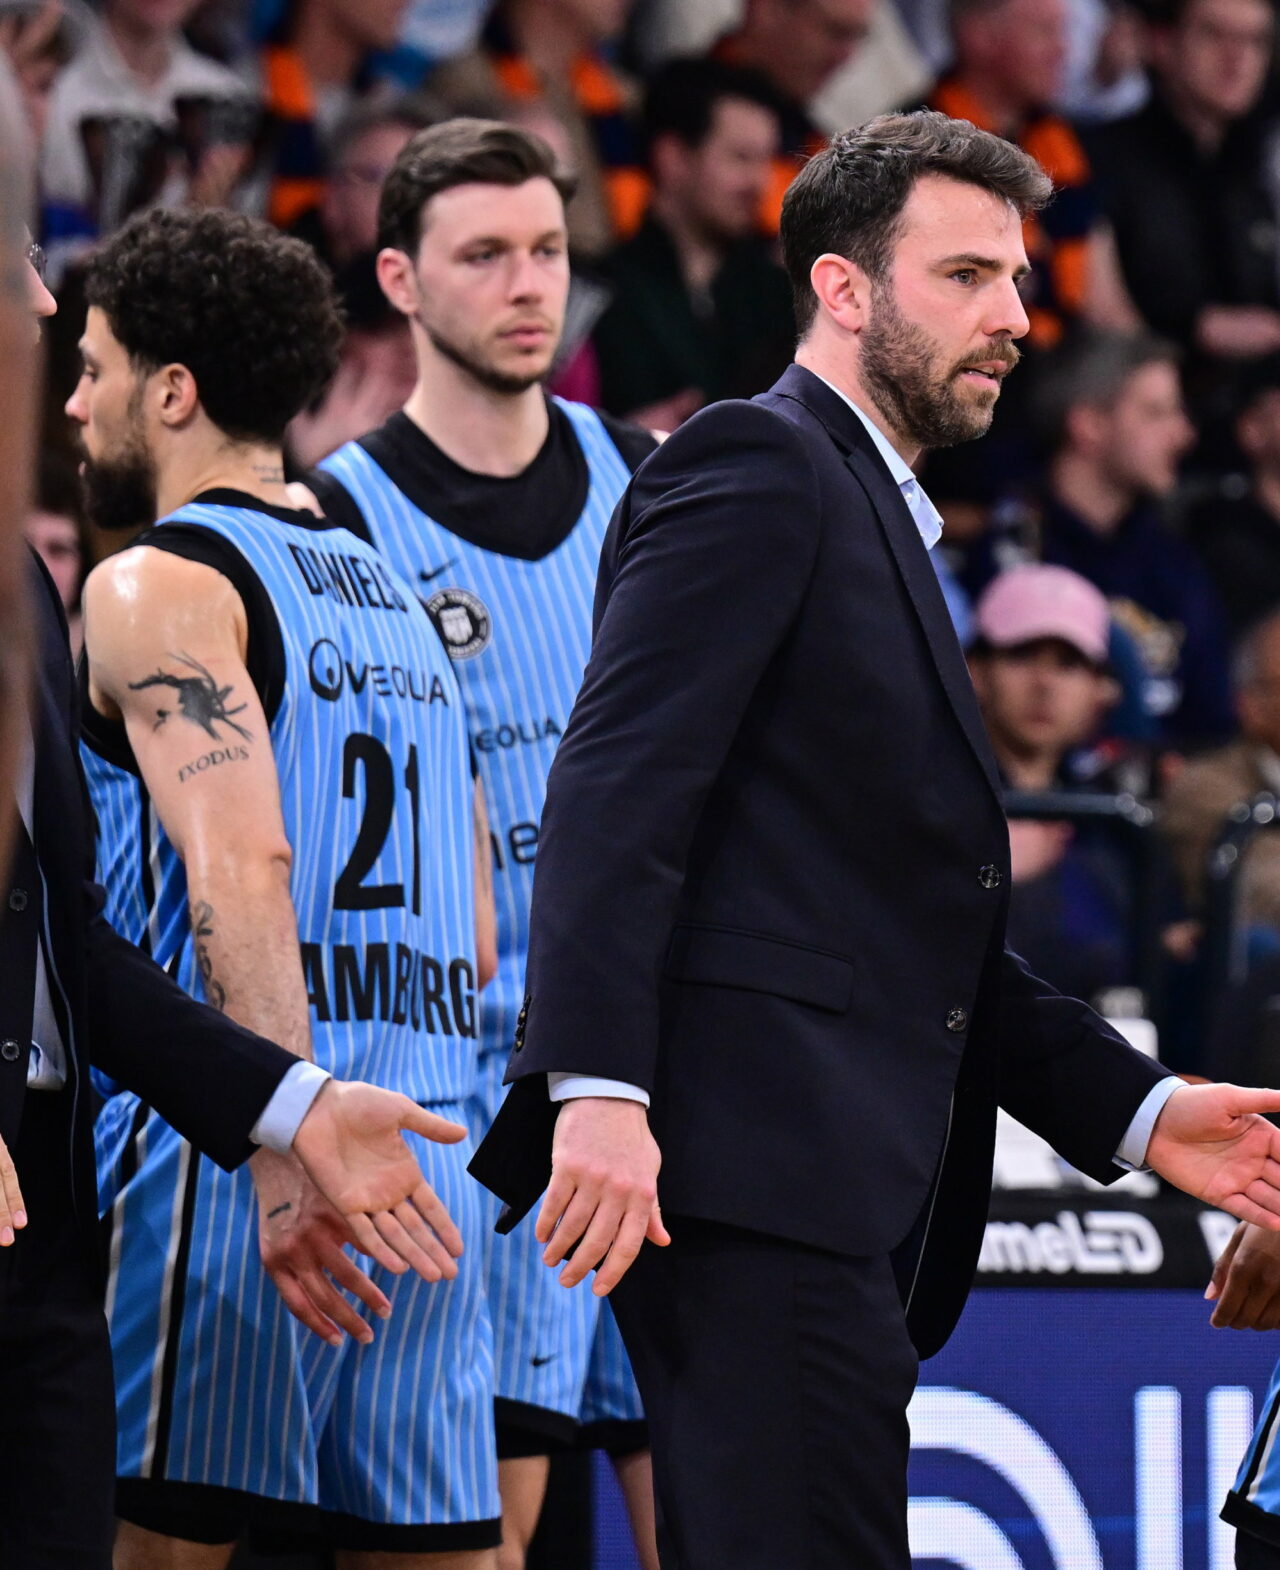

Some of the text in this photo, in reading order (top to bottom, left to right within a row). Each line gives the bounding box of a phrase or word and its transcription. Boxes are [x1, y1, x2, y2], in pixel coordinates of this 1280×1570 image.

[345, 660, 449, 706] VEOLIA
[475, 717, 562, 752] EOLIA
[333, 732, 421, 917] 21
[301, 942, 477, 1039] AMBURG
